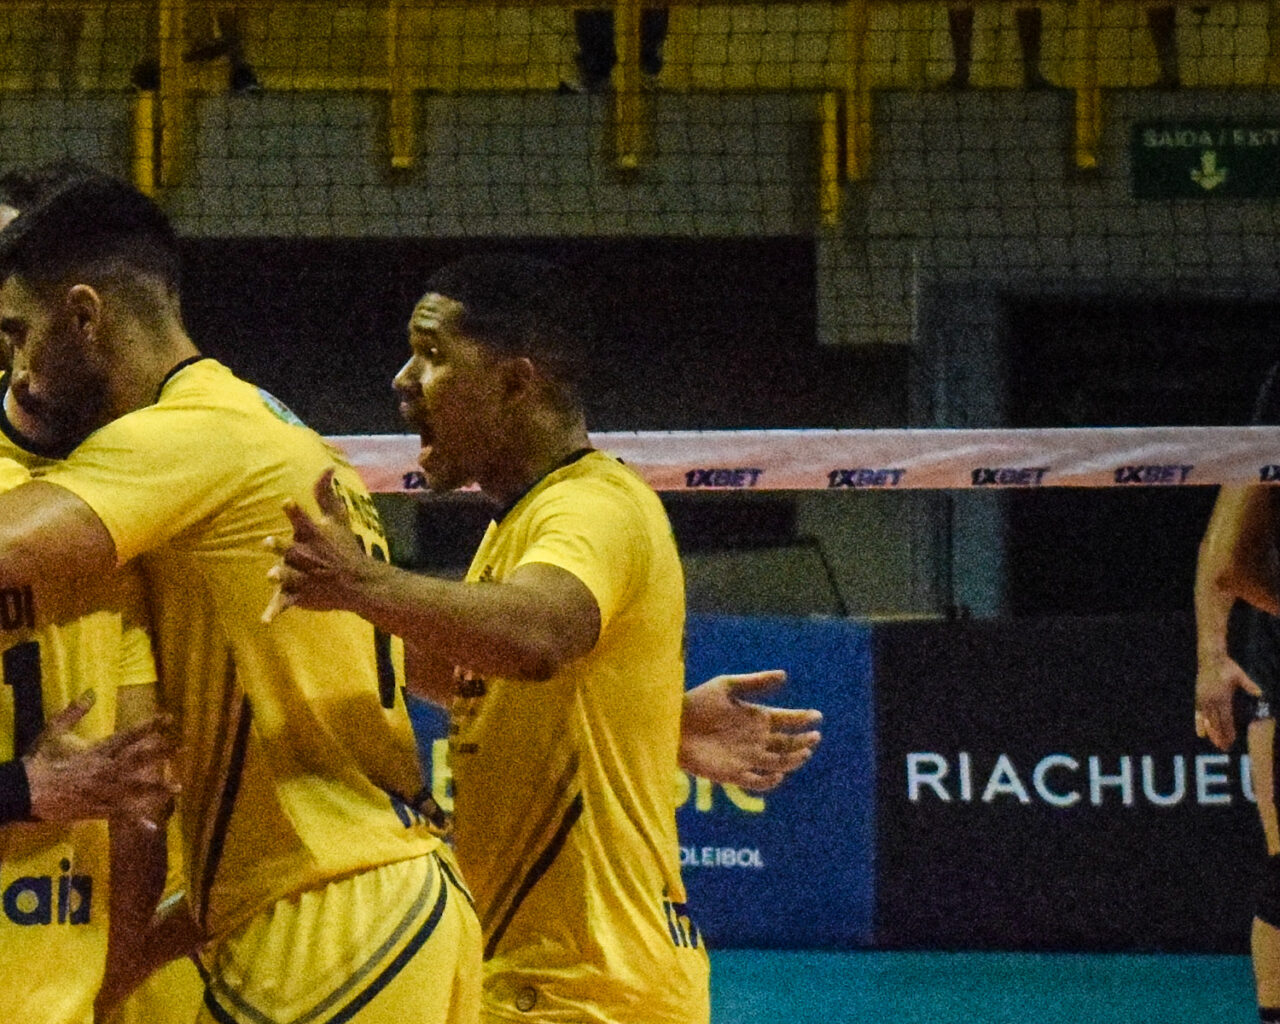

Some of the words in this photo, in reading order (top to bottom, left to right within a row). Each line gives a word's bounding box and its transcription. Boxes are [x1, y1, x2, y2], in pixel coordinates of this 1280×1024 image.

[685, 468, 763, 488] 1XBET
[827, 468, 906, 488] 1XBET
[971, 466, 1051, 486] 1XBET
[1114, 464, 1194, 484] 1XBET
